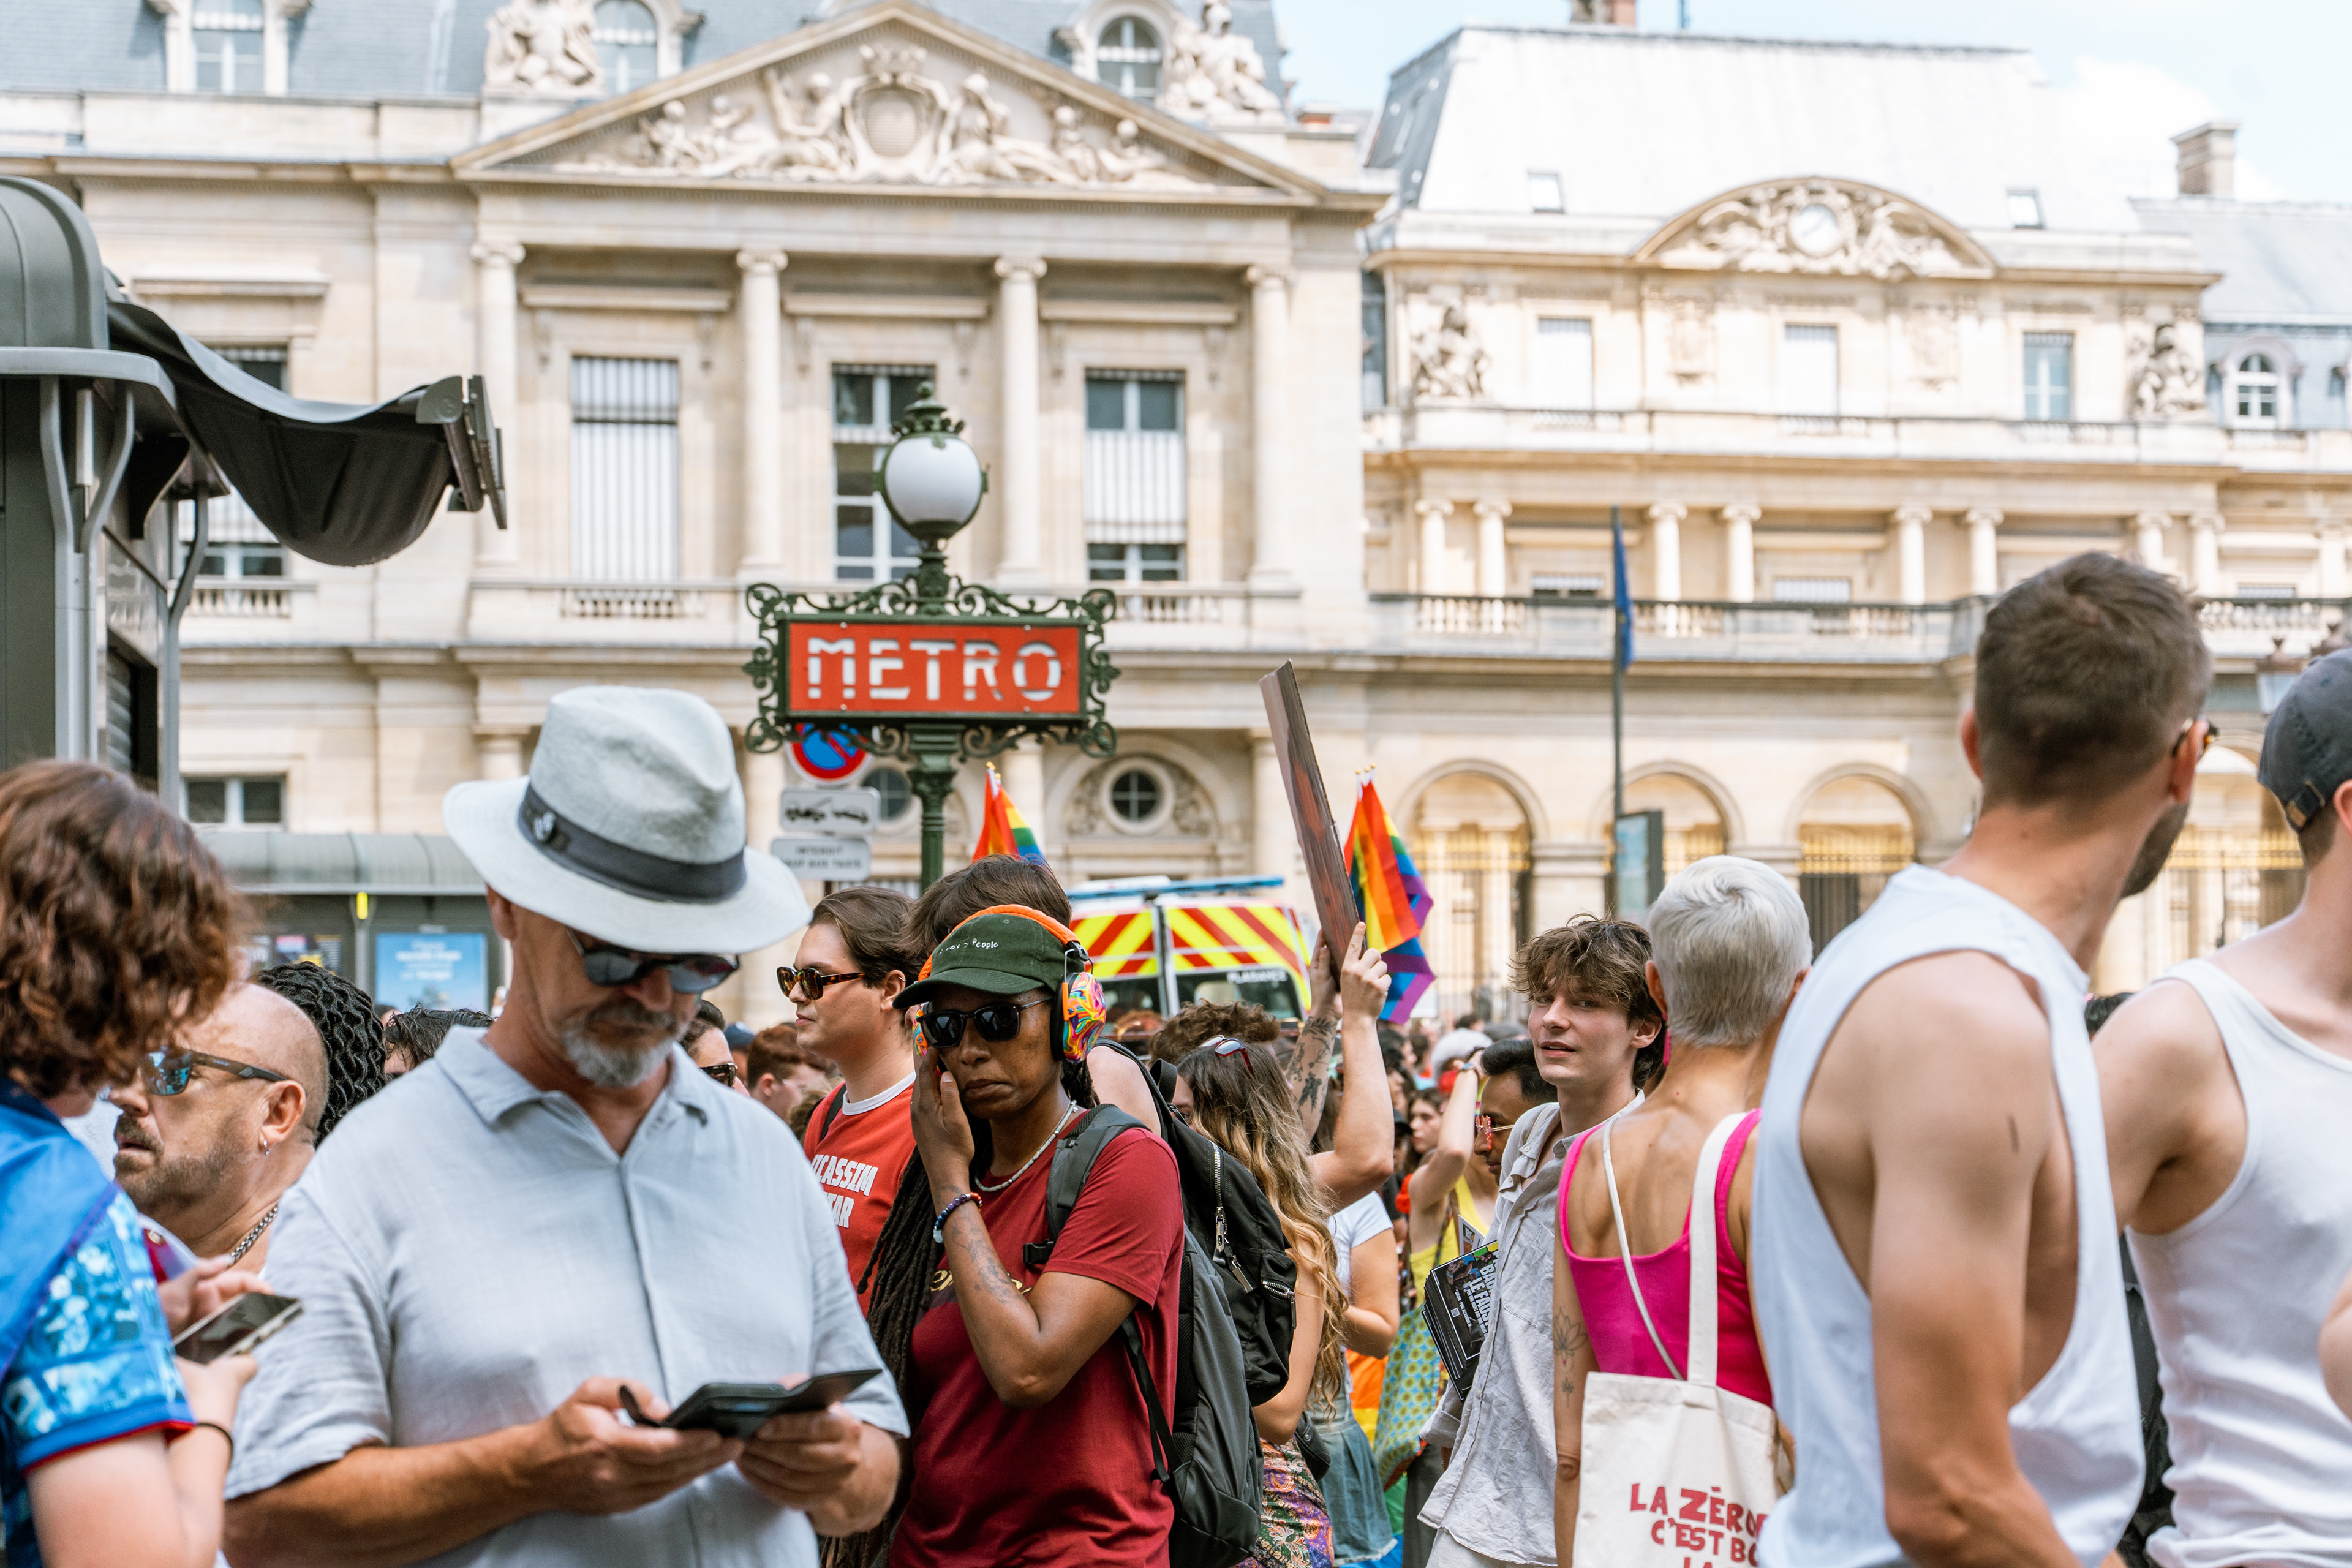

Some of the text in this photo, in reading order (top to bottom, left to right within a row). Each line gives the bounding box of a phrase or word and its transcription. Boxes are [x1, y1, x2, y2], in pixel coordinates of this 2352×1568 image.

[808, 637, 1061, 701] METRO
[972, 938, 998, 950] People
[1630, 1483, 1668, 1515] LA
